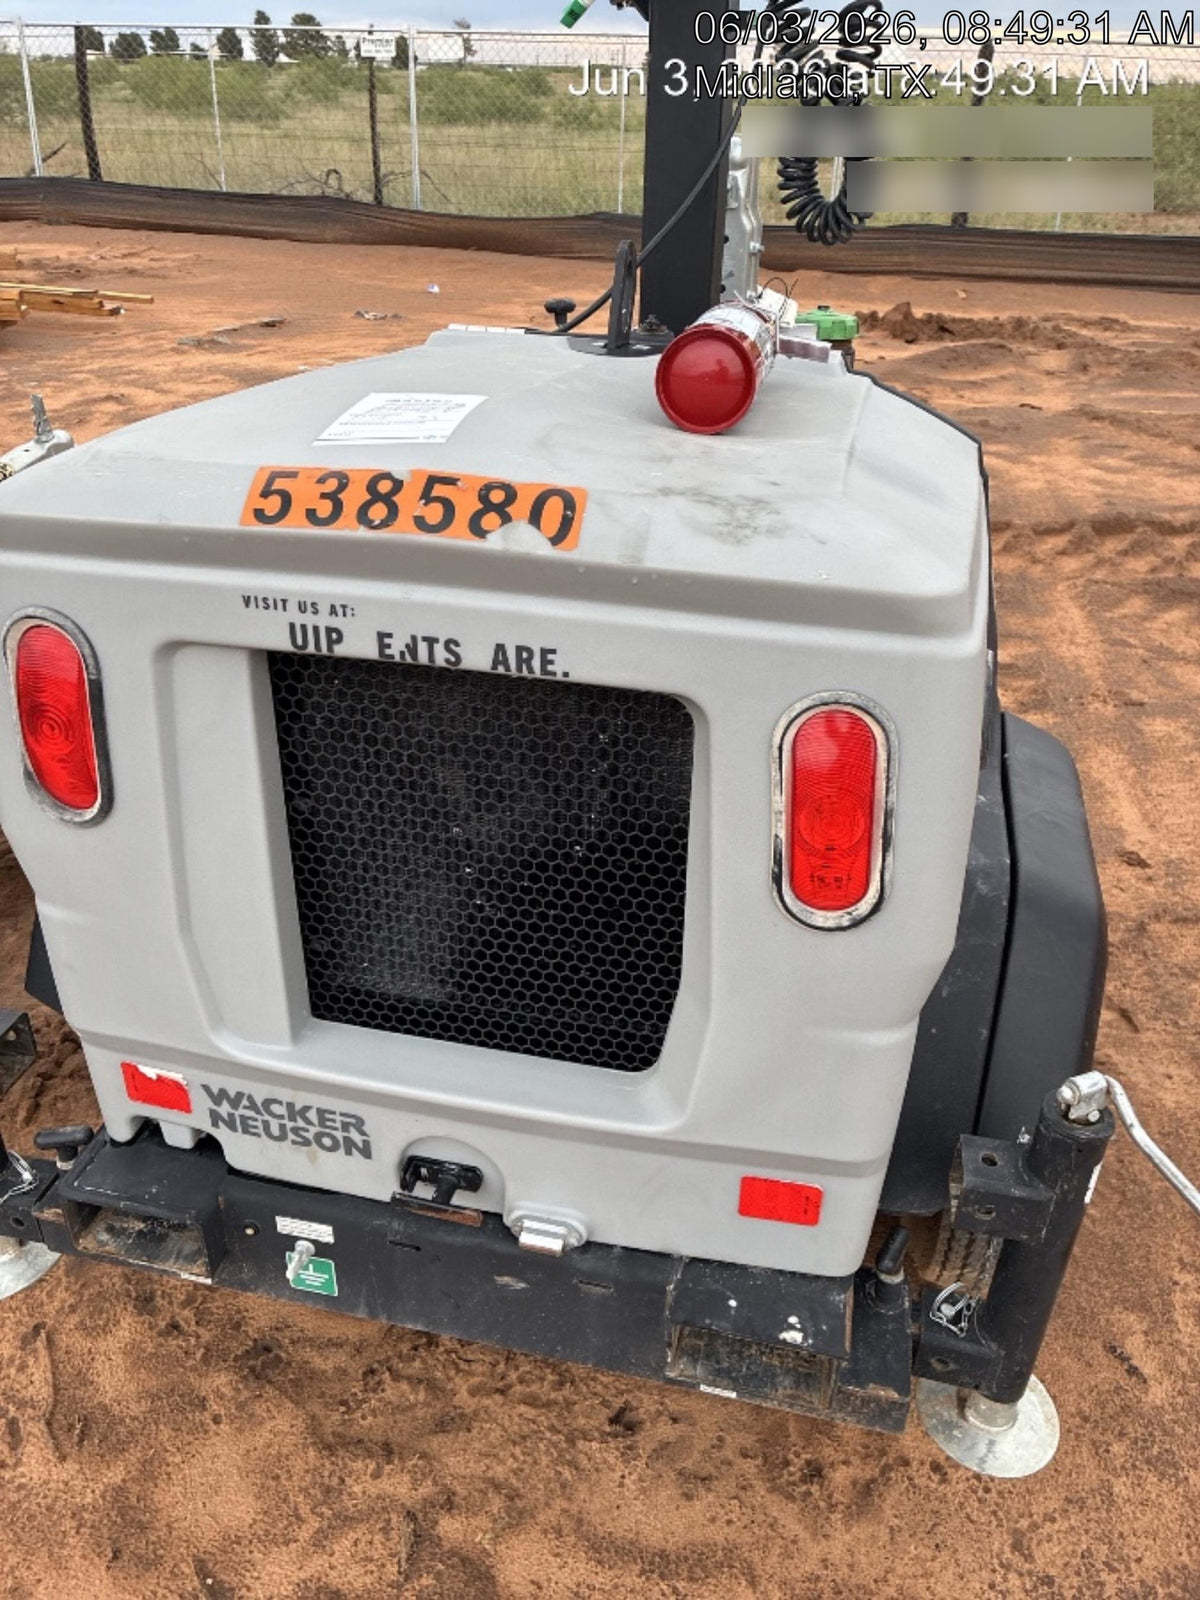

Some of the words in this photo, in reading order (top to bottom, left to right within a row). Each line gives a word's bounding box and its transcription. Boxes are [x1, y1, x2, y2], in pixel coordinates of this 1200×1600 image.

[253, 470, 577, 546] 538580
[242, 595, 288, 612] VISIT
[298, 601, 320, 616] US
[328, 604, 356, 618] AT:
[200, 1084, 370, 1137] WACKER
[208, 1107, 373, 1160] NEUSON
